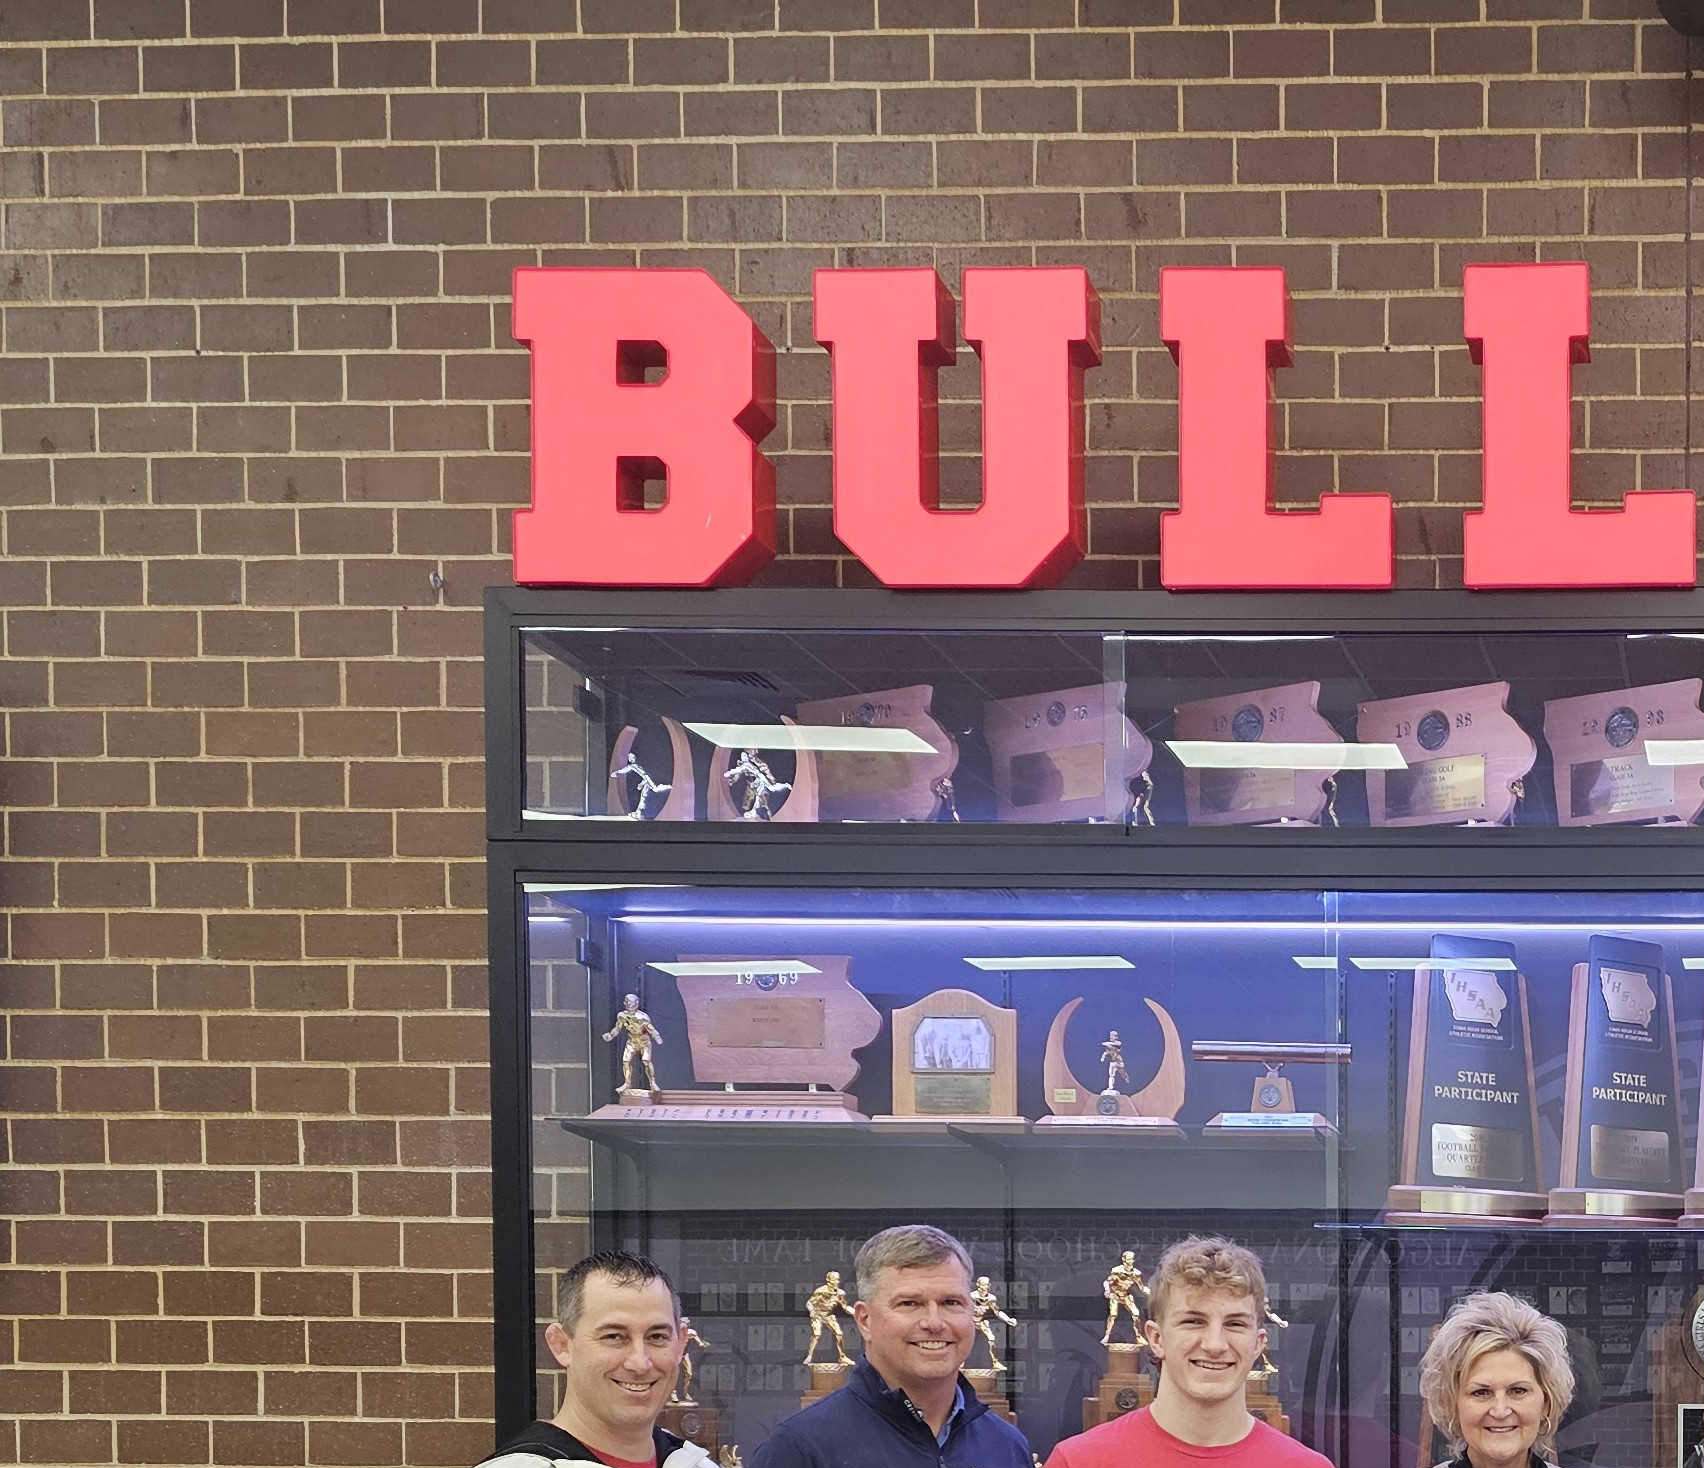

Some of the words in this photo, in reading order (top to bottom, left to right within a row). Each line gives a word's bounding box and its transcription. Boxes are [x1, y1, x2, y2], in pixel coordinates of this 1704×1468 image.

[1396, 721, 1412, 739] 19
[1455, 712, 1473, 729] 88
[1610, 763, 1634, 773] TRACK
[735, 972, 754, 985] 19
[778, 972, 799, 986] 69
[1450, 972, 1496, 1019] IHSAA
[1457, 1070, 1497, 1086] STATE
[1612, 1071, 1647, 1087] STATE
[1434, 1085, 1520, 1105] PARTICIPANT
[1592, 1086, 1668, 1106] PARTICIPANT
